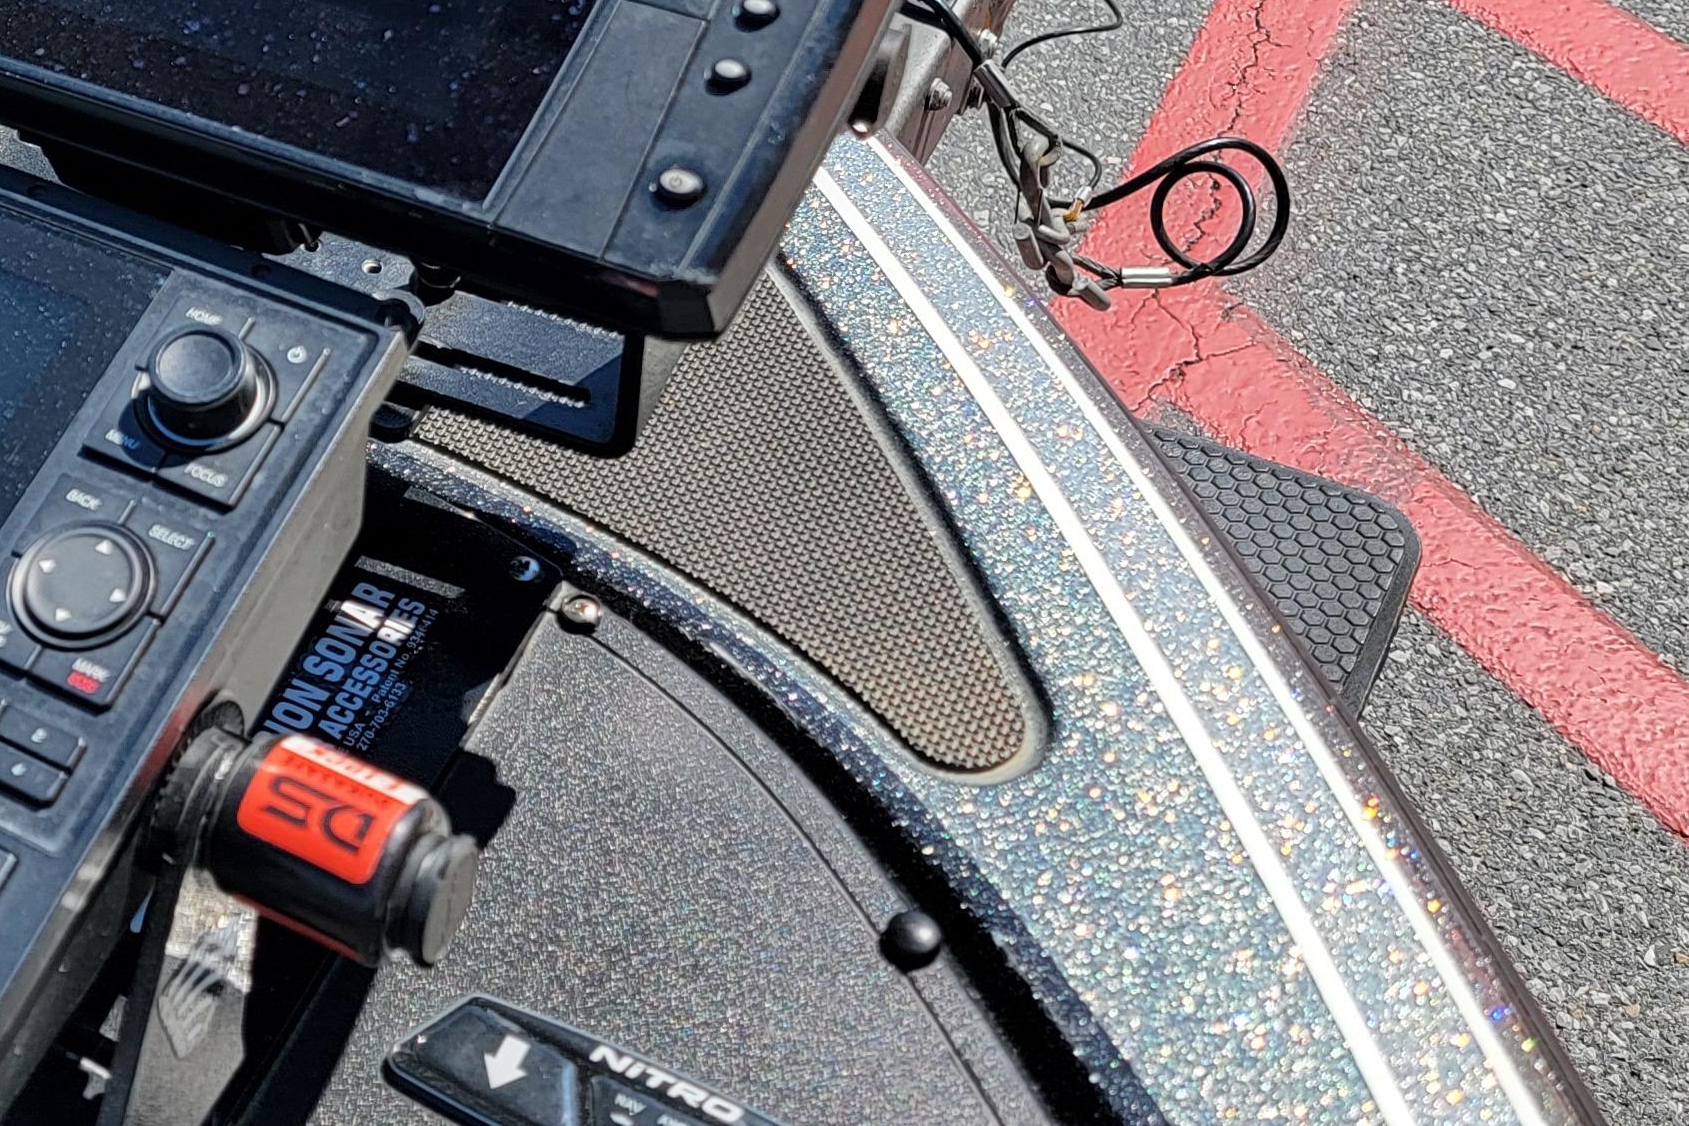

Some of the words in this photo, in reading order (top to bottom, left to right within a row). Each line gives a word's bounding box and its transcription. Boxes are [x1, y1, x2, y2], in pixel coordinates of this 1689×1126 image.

[185, 306, 223, 325] HOME
[104, 428, 140, 450] MENU
[66, 488, 102, 510] BACK
[184, 463, 228, 487] FOCUS
[148, 524, 196, 550] SELECT
[303, 581, 396, 683] SONAR
[318, 597, 425, 741] ACCESSORIES
[344, 722, 366, 748] USA
[372, 668, 400, 704] Patent
[357, 681, 408, 751] 270-703-6133
[589, 1045, 745, 1124] NITRO
